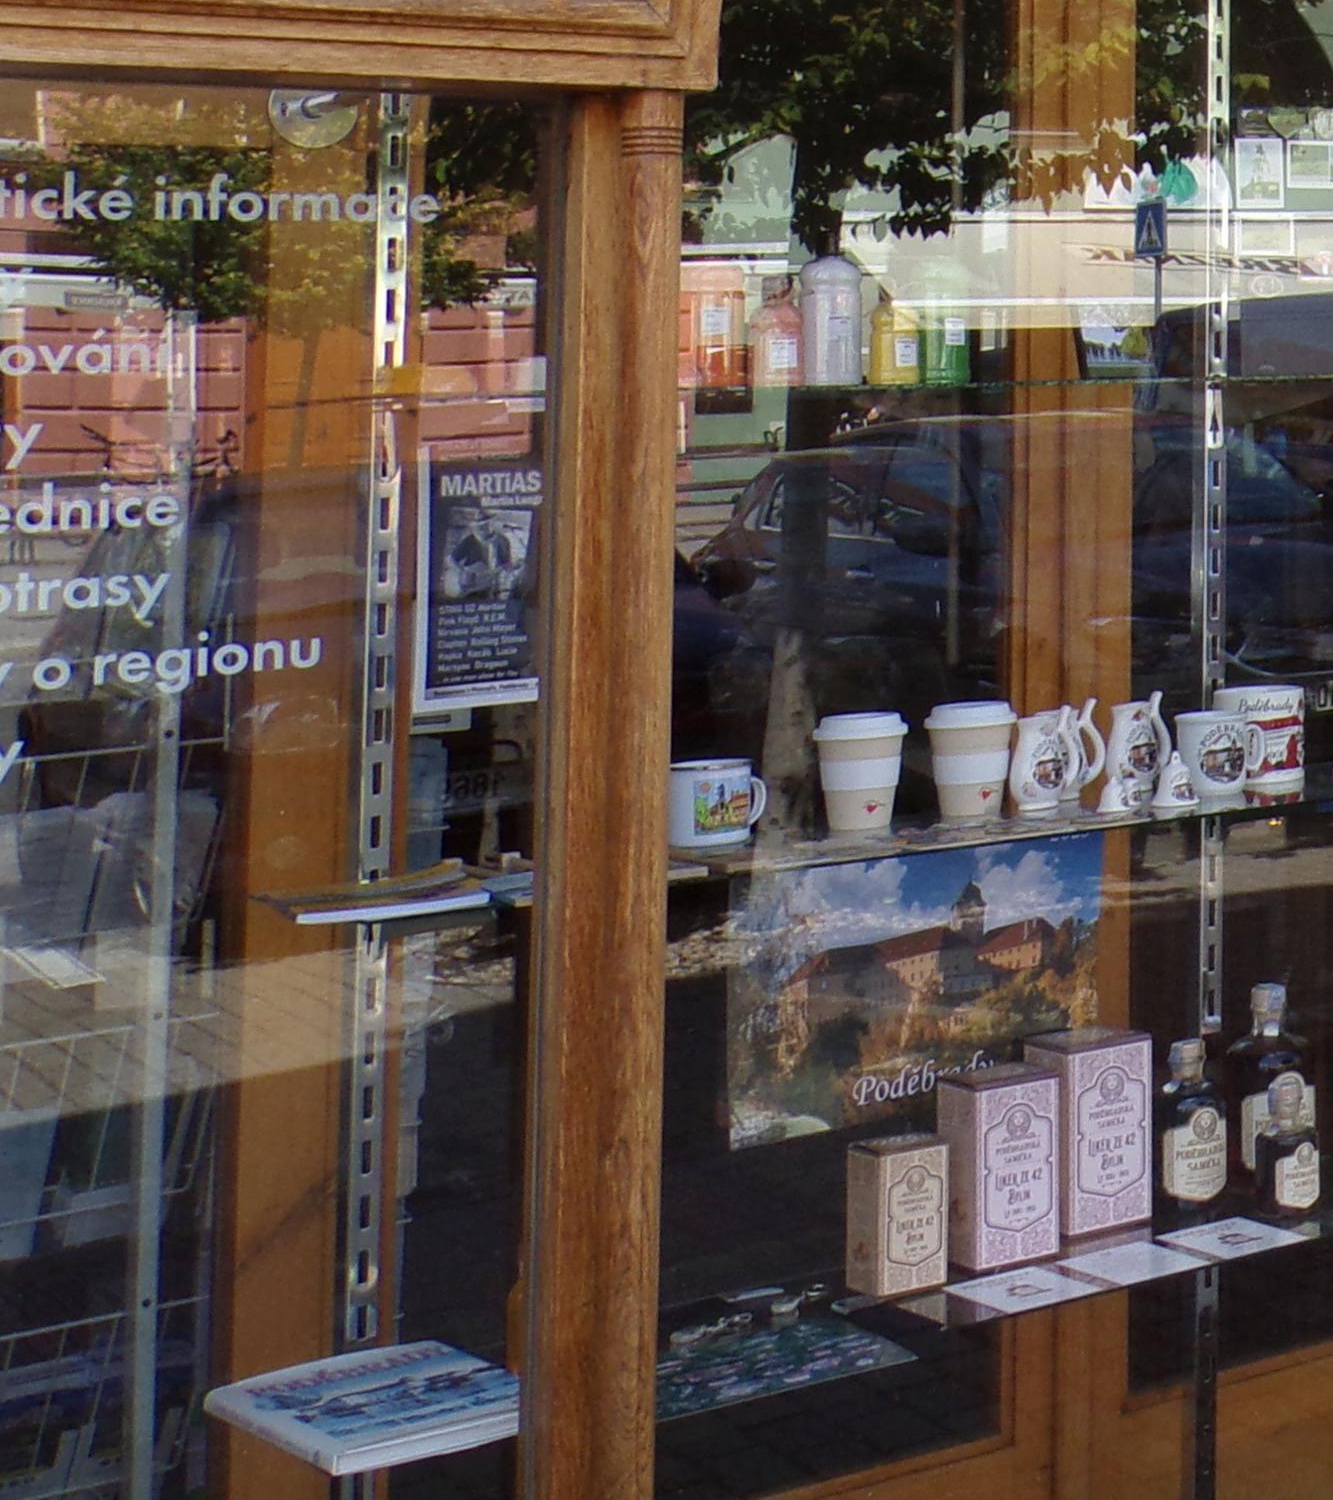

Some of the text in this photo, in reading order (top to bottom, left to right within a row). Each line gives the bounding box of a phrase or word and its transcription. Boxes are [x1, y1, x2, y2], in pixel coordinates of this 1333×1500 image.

[154, 173, 441, 222] informace
[0, 573, 171, 627] trasy
[33, 658, 70, 689] o
[93, 632, 321, 693] regionu
